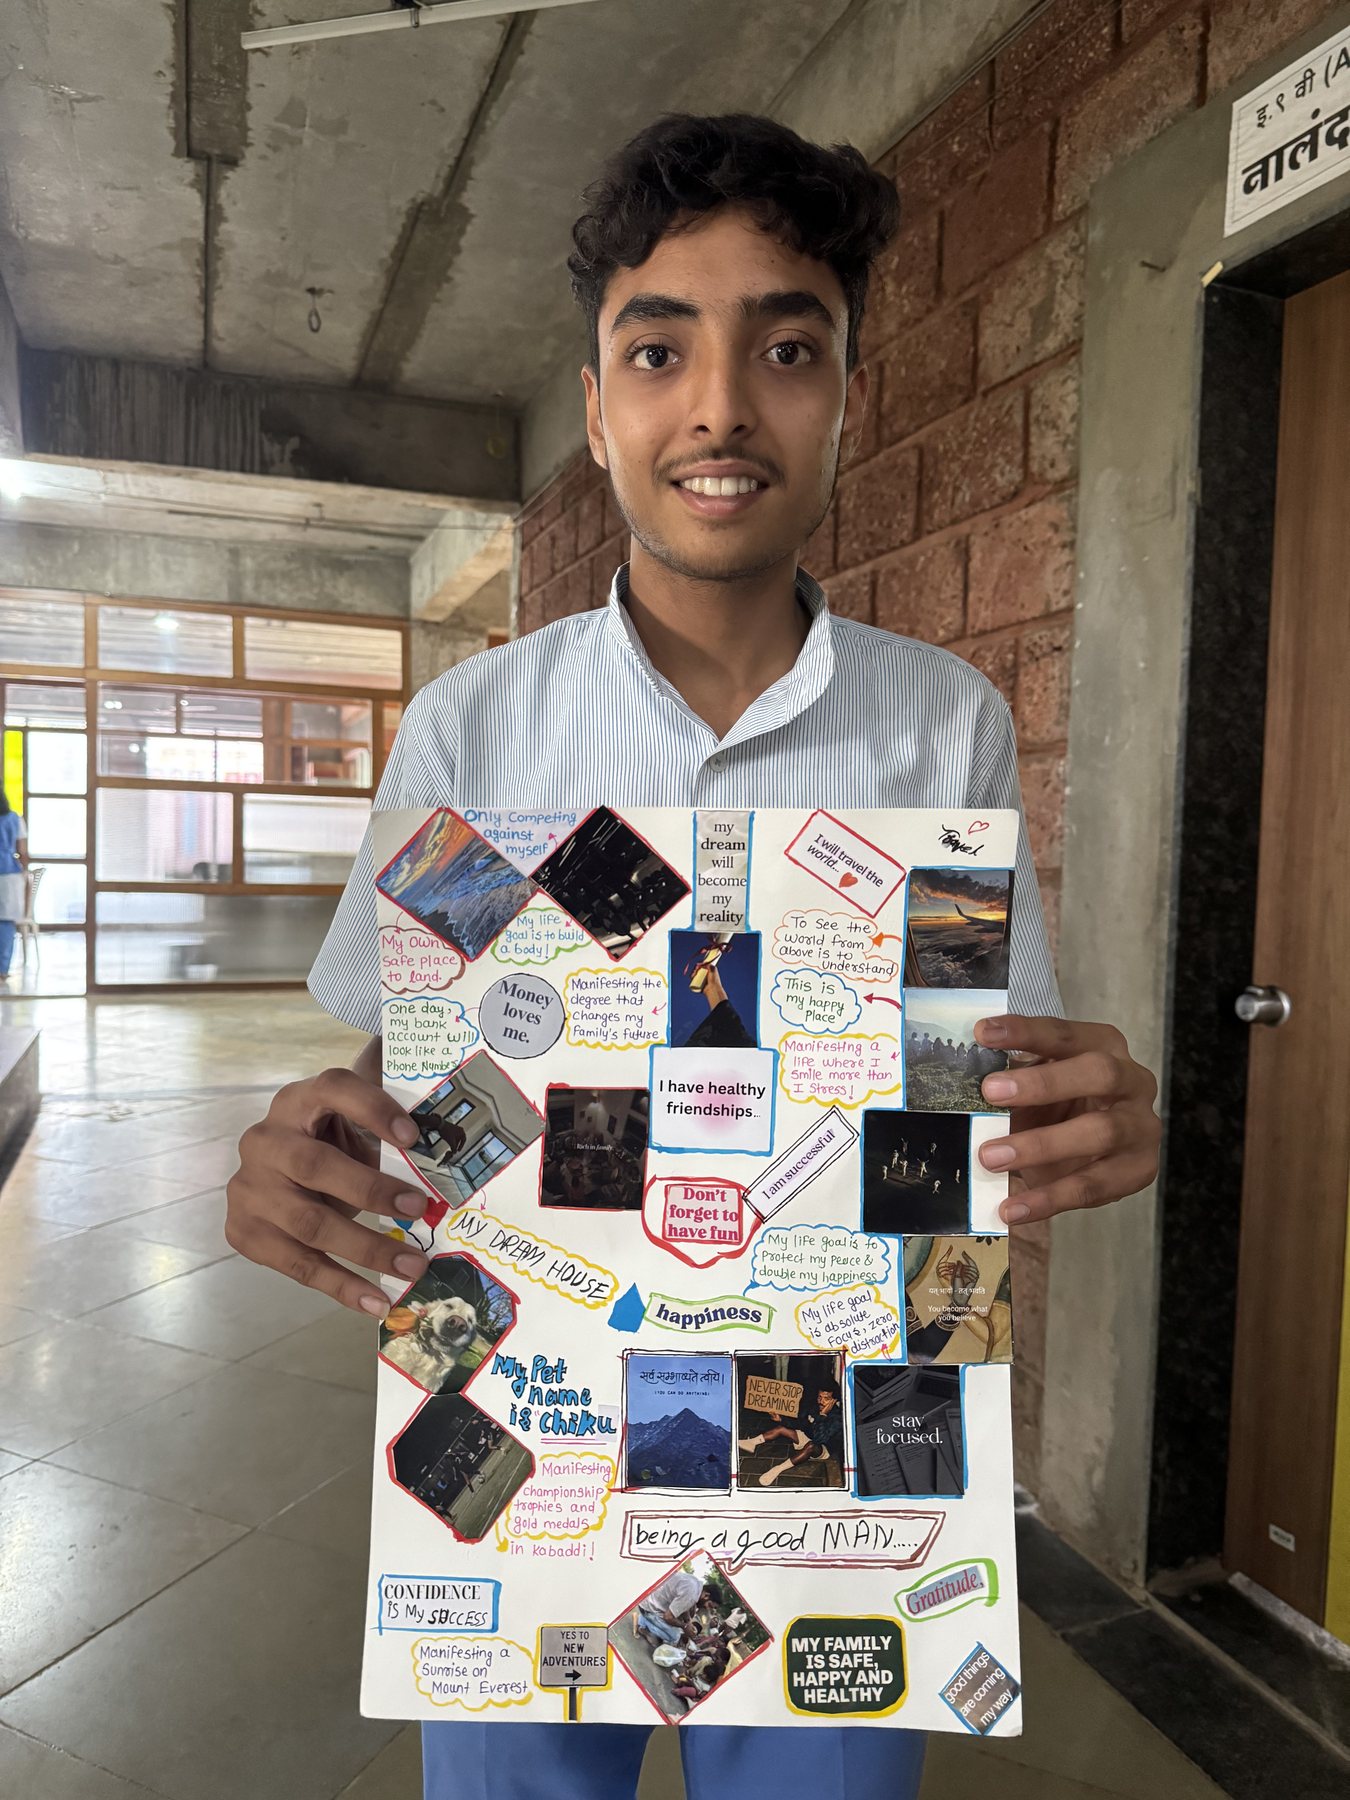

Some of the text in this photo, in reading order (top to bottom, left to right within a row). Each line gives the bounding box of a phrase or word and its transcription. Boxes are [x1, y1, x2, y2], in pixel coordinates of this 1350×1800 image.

[1295, 68, 1316, 97] वी
[464, 809, 501, 827] Only
[483, 827, 534, 843] against
[714, 823, 734, 836] my
[505, 843, 548, 859] myself
[701, 837, 746, 851] dream
[712, 856, 734, 868] will
[814, 833, 884, 887] I will travel the
[698, 873, 747, 886] become
[712, 895, 732, 908] my
[517, 915, 561, 928] My life
[700, 910, 744, 926] reality
[791, 916, 871, 933] To the
[506, 929, 584, 942] goal is to build
[831, 934, 864, 950] from
[382, 935, 403, 954] My
[420, 955, 457, 969] place
[818, 948, 852, 960] is to
[388, 971, 401, 981] to
[571, 977, 662, 994] Manifesting the
[784, 978, 835, 994] This is
[498, 980, 554, 1010] Money
[570, 994, 644, 1009] degree that
[502, 1002, 542, 1025] loves
[786, 995, 844, 1016] my happy
[390, 1018, 447, 1030] my bank
[625, 1014, 644, 1028] my
[388, 1031, 475, 1043] account will
[502, 1026, 529, 1043] me.
[623, 1028, 659, 1040] future
[389, 1045, 452, 1056] look like a
[784, 1040, 881, 1056] Manifesting a
[387, 1060, 417, 1072] Phone
[794, 1056, 814, 1067] life
[871, 1058, 880, 1067] I
[829, 1069, 892, 1080] more than
[659, 1079, 766, 1099] I have healthy
[794, 1084, 803, 1093] I
[762, 1129, 836, 1199] I am successful
[683, 1187, 727, 1203] Don't
[669, 1204, 738, 1225] forget to
[667, 1223, 738, 1241] have fun
[768, 1234, 878, 1252] My life goal is to
[489, 1229, 610, 1299] DREAM HOUSE
[810, 1254, 874, 1268] my &
[759, 1265, 877, 1285] double my happiness
[802, 1289, 872, 1324] My life goal
[928, 1305, 941, 1313] You
[656, 1303, 762, 1330] happiness
[809, 1309, 871, 1339] is absolute
[868, 1313, 893, 1330] zero
[491, 1352, 567, 1399] My Pet
[528, 1385, 592, 1407] name
[749, 1379, 802, 1398] NEVER STOP
[748, 1393, 796, 1413] DREAMING.
[509, 1402, 532, 1431] is
[892, 1415, 924, 1431] stay
[876, 1427, 943, 1444] focused.
[542, 1461, 611, 1483] Manifesting
[514, 1499, 595, 1516] trophies and
[514, 1516, 589, 1534] gold medals
[511, 1541, 524, 1555] in
[636, 1520, 808, 1564] being a good
[384, 1584, 480, 1600] CONFIDENCE
[560, 1631, 589, 1639] YES TO
[564, 1643, 585, 1653] NEW
[792, 1636, 892, 1652] MY FAMILY
[420, 1646, 510, 1667] Manifesting a
[542, 1656, 606, 1667] ADVENTURES
[806, 1653, 879, 1670] IS SAFE,
[472, 1667, 487, 1677] on
[793, 1670, 893, 1686] HAPPY AND
[945, 1652, 990, 1704] good things
[432, 1681, 528, 1694] Mount Everest
[804, 1688, 884, 1703] HEALTHY
[961, 1668, 1006, 1716] are coming
[980, 1689, 1013, 1726] my way
